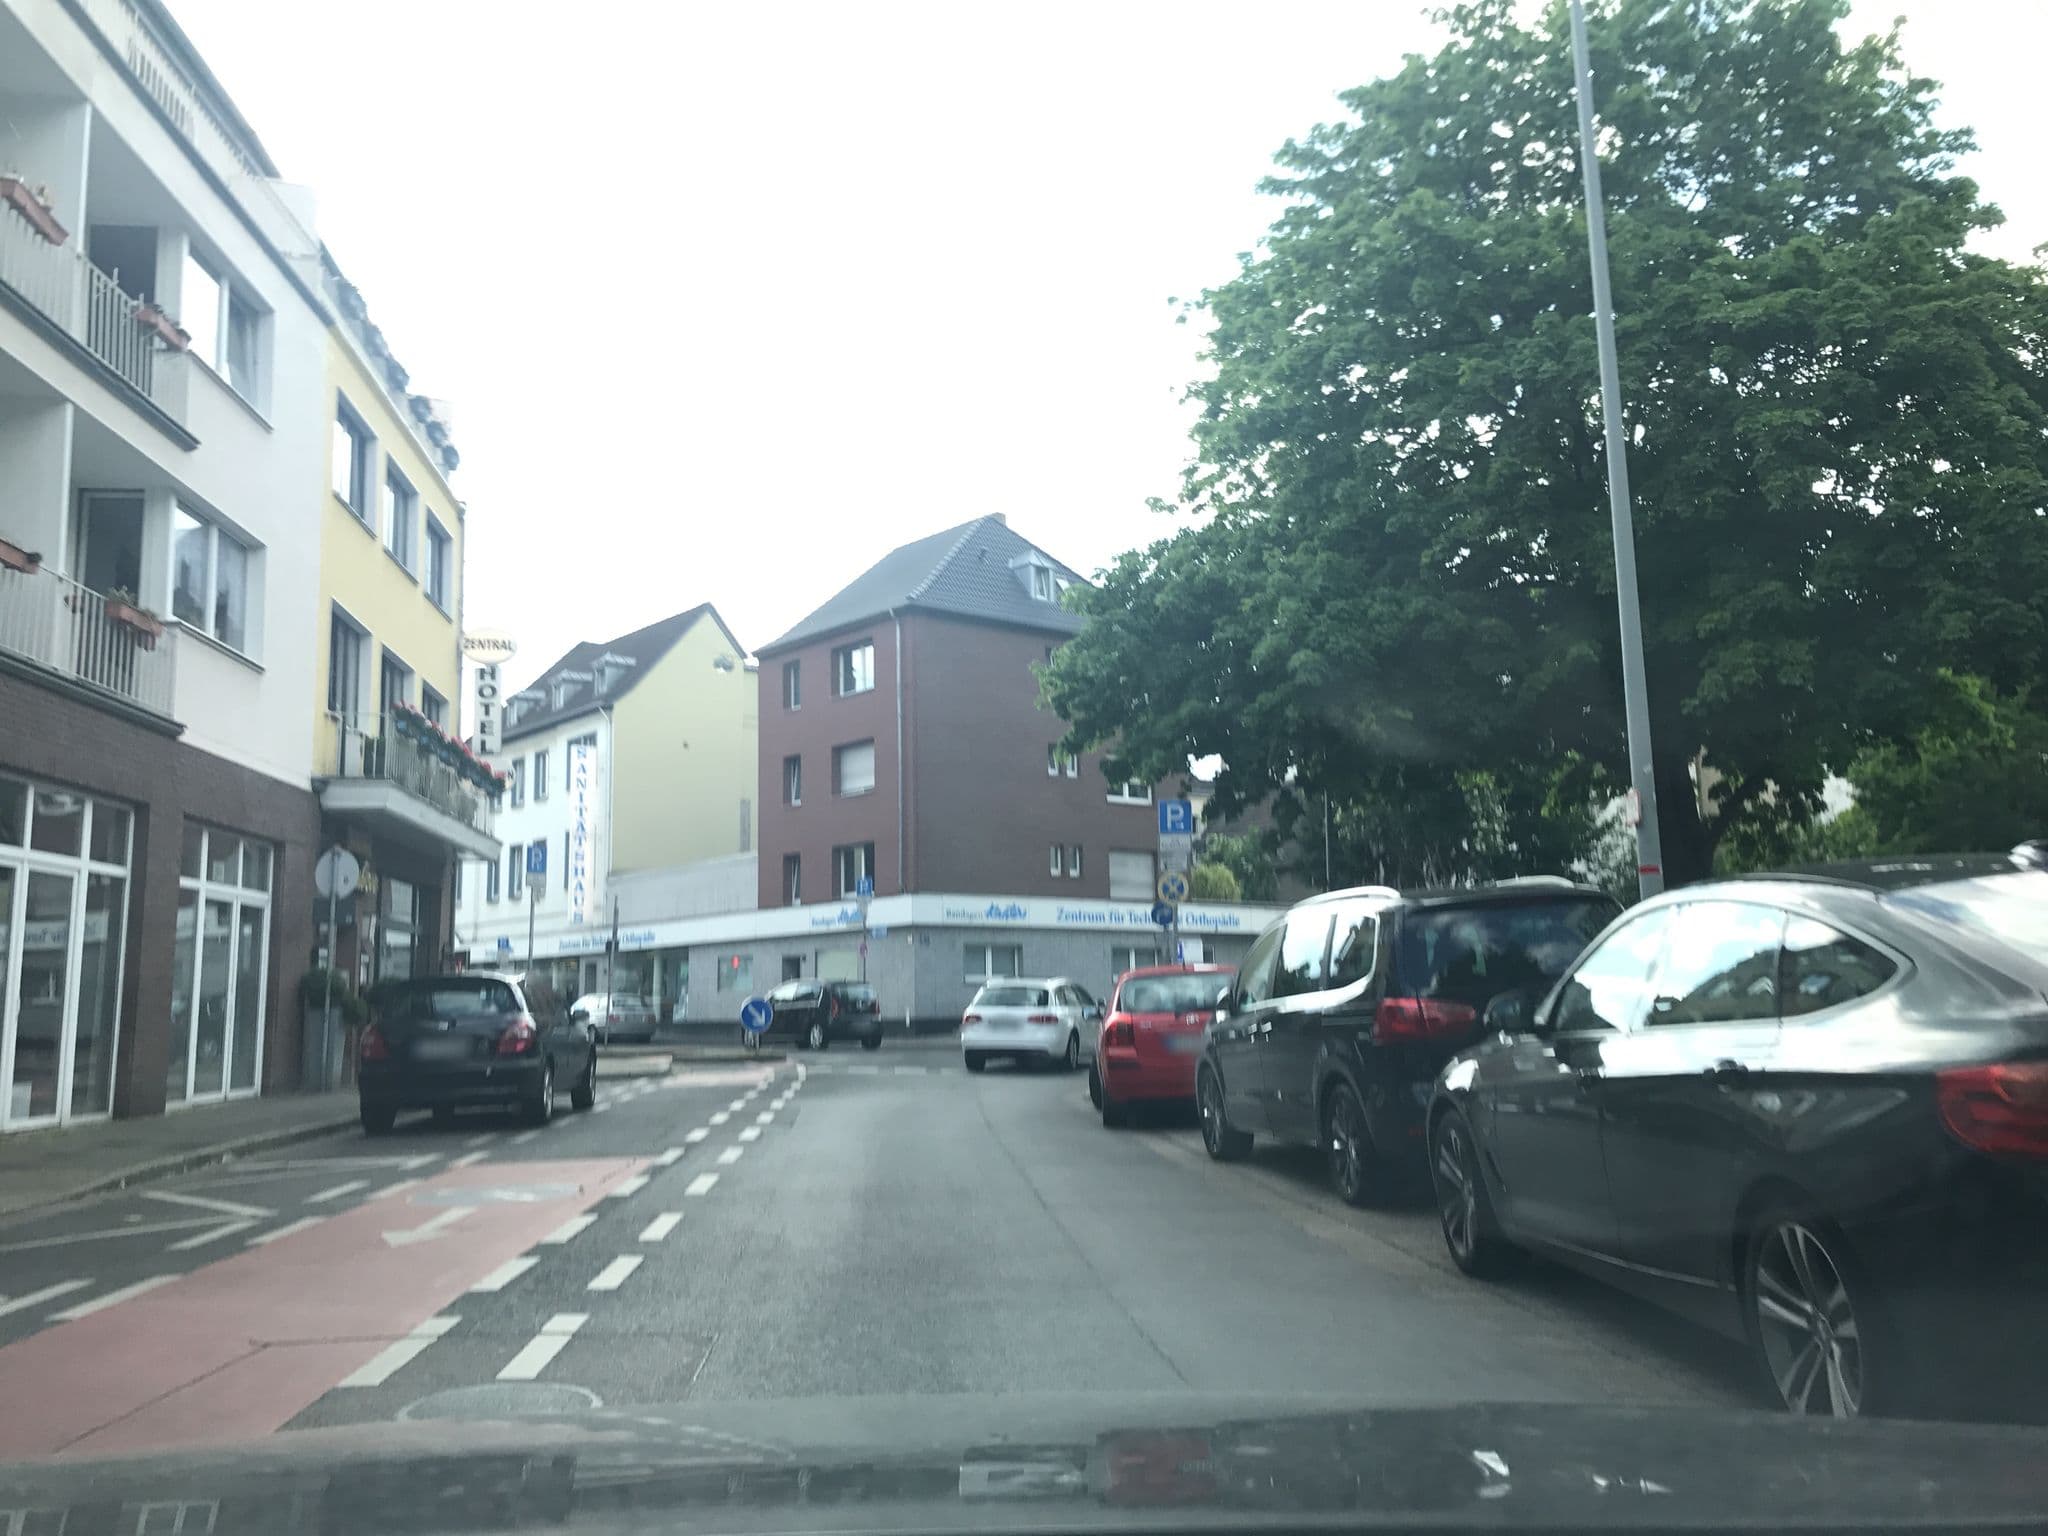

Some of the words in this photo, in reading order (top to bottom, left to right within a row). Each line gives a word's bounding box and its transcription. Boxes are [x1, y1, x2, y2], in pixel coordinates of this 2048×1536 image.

[464, 636, 514, 652] ZENTRAL
[476, 667, 498, 754] HOTEL
[1056, 905, 1106, 922] Zentrum
[1109, 908, 1126, 923] für
[1185, 913, 1241, 931] Orthopädie
